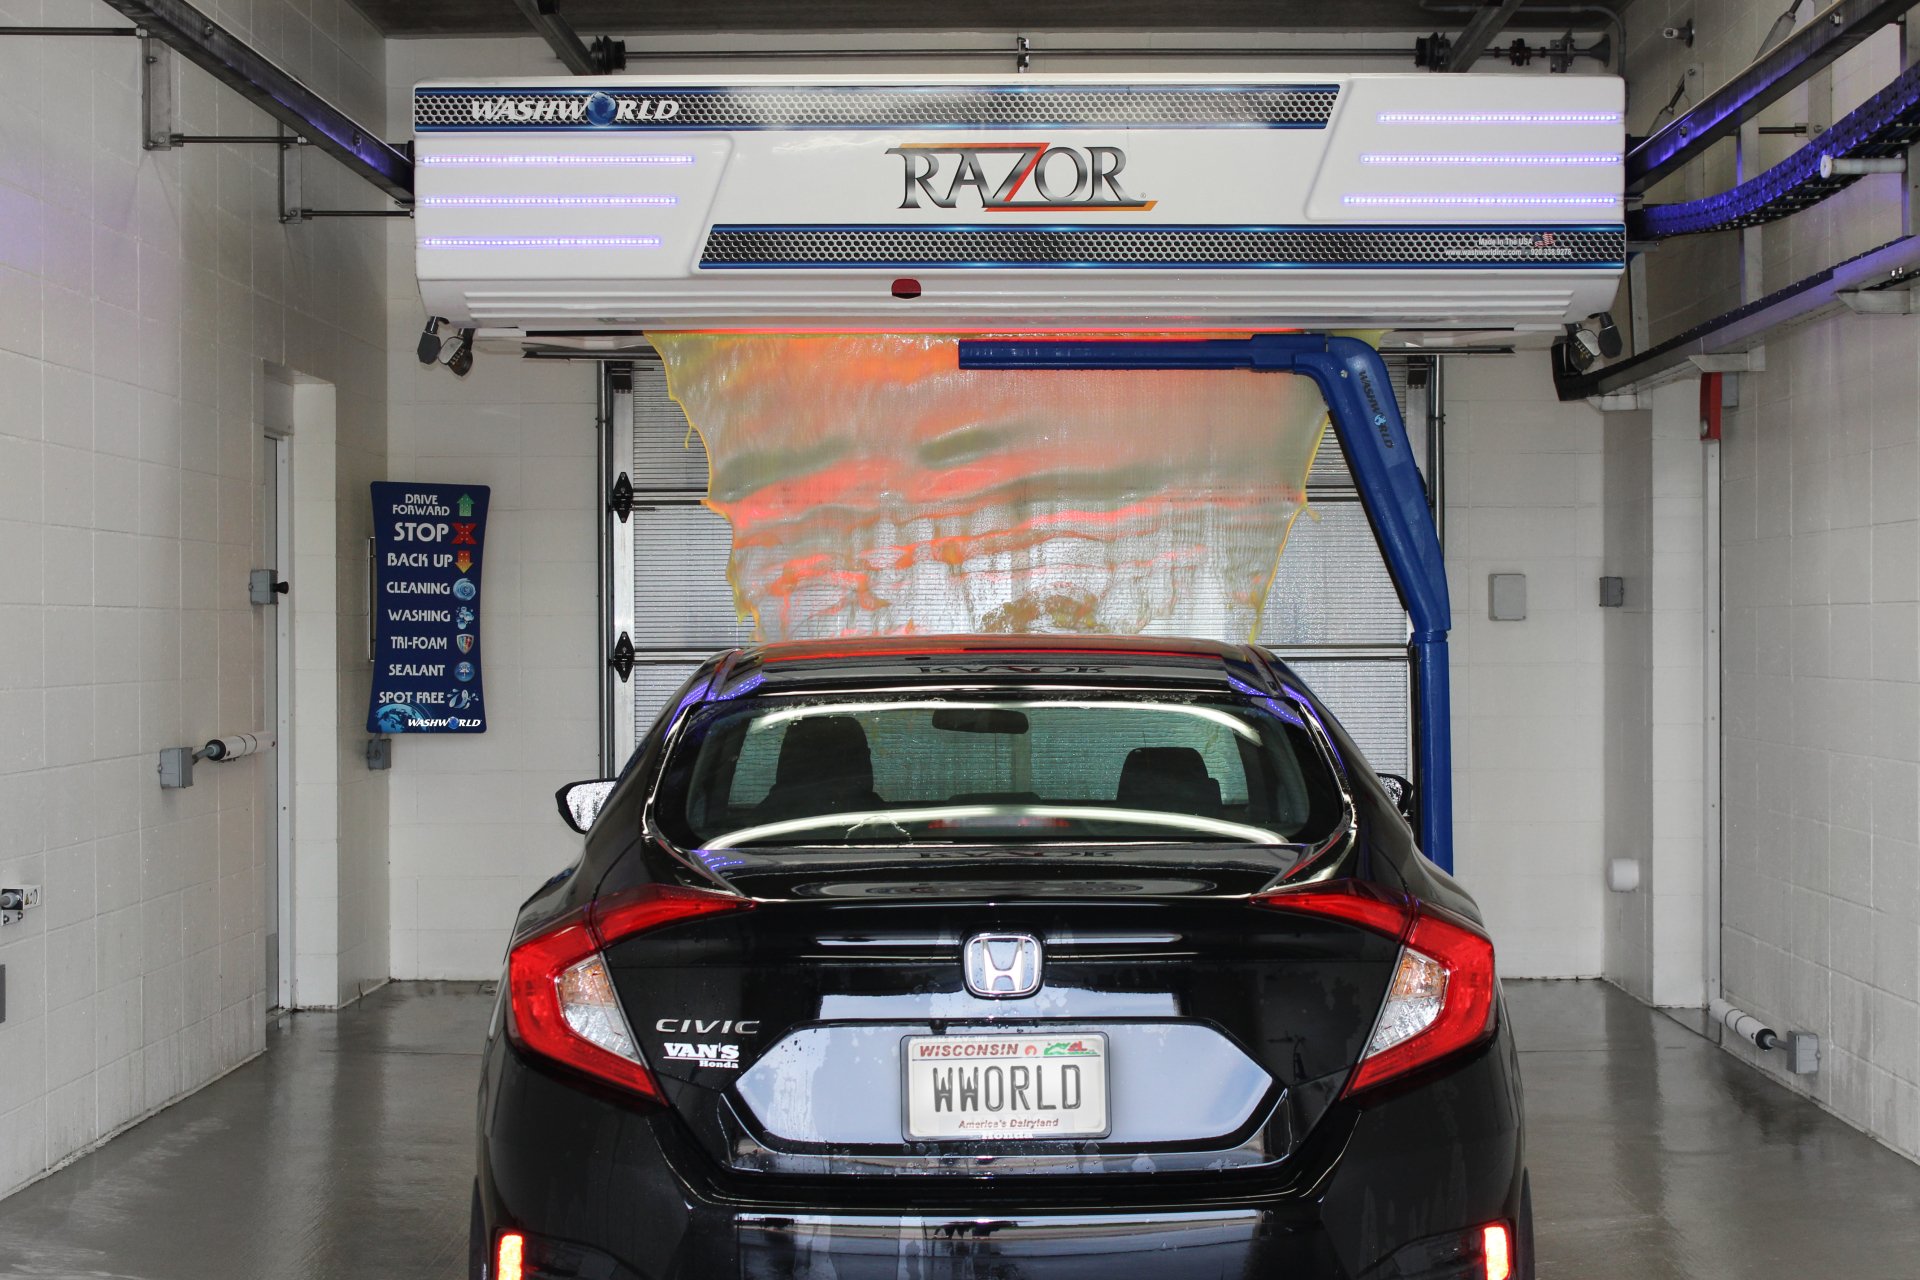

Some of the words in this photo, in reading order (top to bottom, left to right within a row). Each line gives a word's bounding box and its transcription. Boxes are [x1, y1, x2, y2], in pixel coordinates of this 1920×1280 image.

[885, 143, 1158, 212] RAZOR
[1445, 248, 1522, 256] www.washworldinc.com
[405, 494, 438, 505] DRIVE
[392, 504, 450, 516] FORWARD
[393, 522, 449, 542] STOP
[387, 552, 428, 567] BACK
[433, 554, 453, 568] UP
[386, 581, 450, 595] CLEANING
[388, 609, 451, 622] WASHING
[390, 636, 447, 650] TRI-FOAM
[388, 664, 445, 676] SEALANT
[378, 691, 412, 704] SPOT
[416, 692, 445, 704] FREE
[655, 1018, 760, 1034] CIVIC
[663, 1042, 740, 1059] VAN'S
[919, 1043, 1019, 1057] WISCONSIN
[699, 1060, 739, 1068] Honda
[932, 1064, 1081, 1113] WWORLD
[958, 1119, 1007, 1129] America's
[1009, 1118, 1059, 1129] Dairyland
